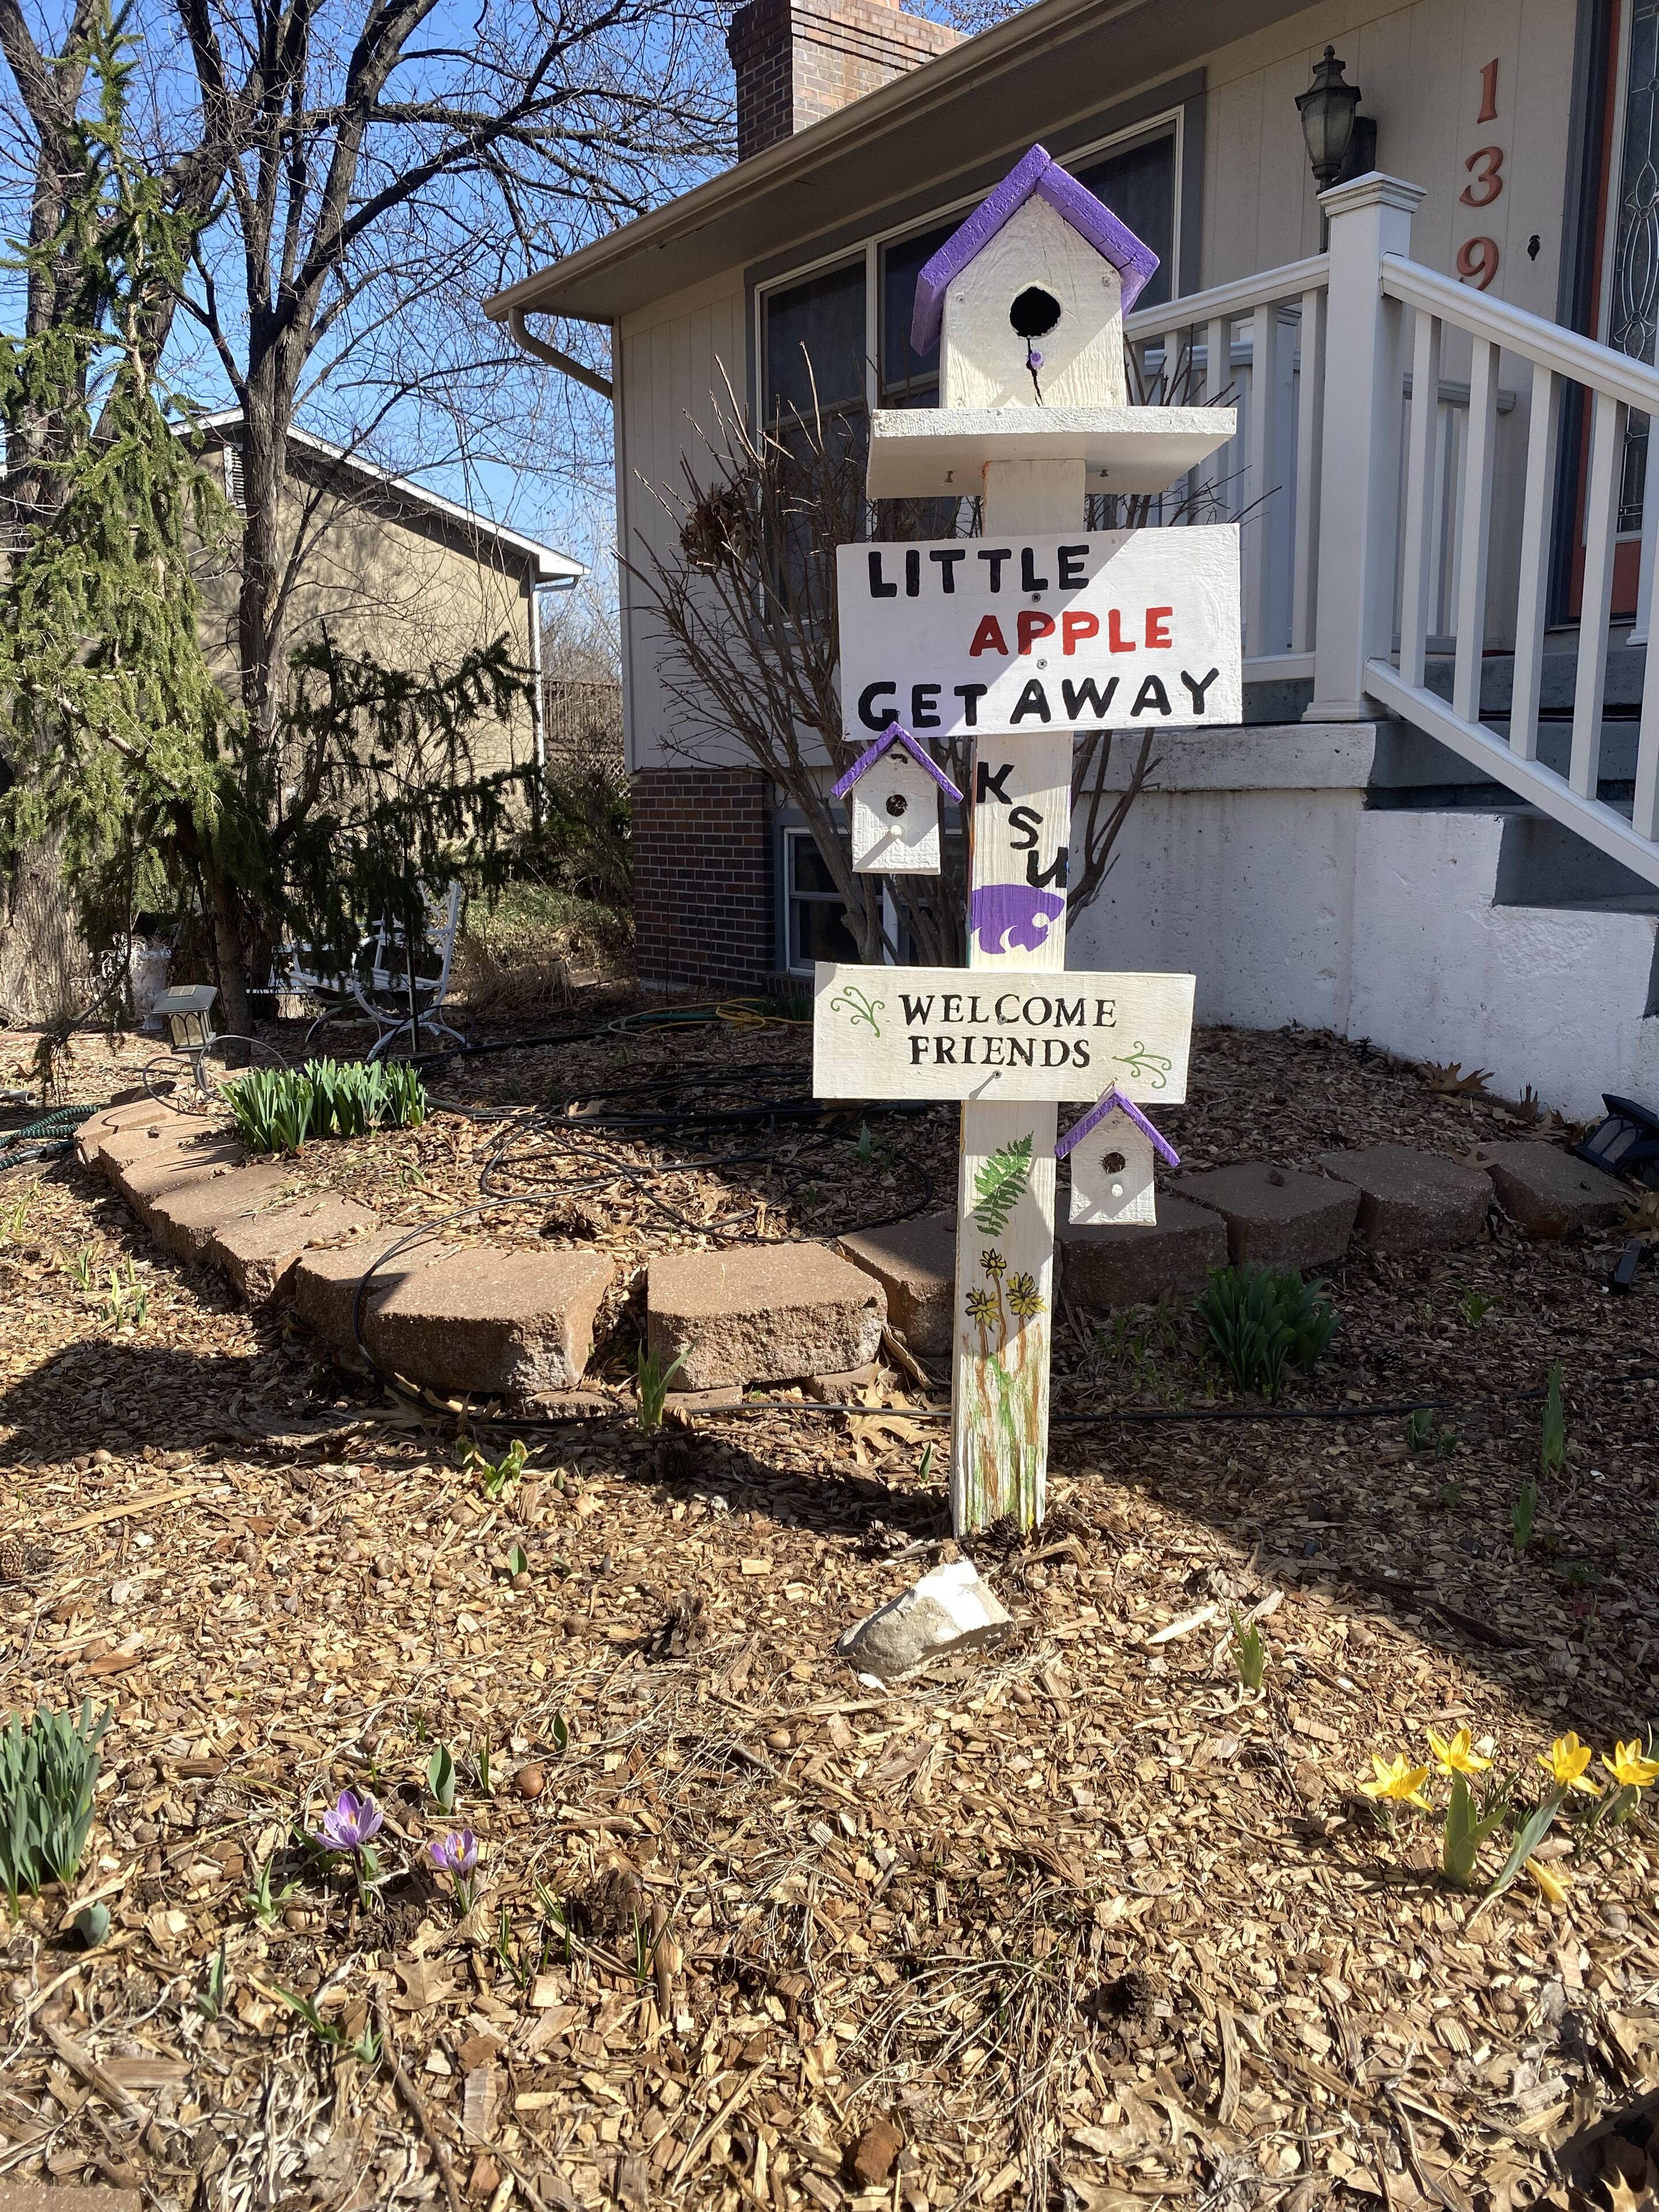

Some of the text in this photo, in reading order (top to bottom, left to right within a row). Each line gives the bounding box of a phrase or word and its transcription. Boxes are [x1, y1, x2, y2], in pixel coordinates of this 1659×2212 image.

[868, 544, 1090, 598] LITTLE
[969, 606, 1173, 657] APPLE
[898, 994, 1117, 1028] WELCOME
[907, 1035, 1091, 1069] FRIENDS
